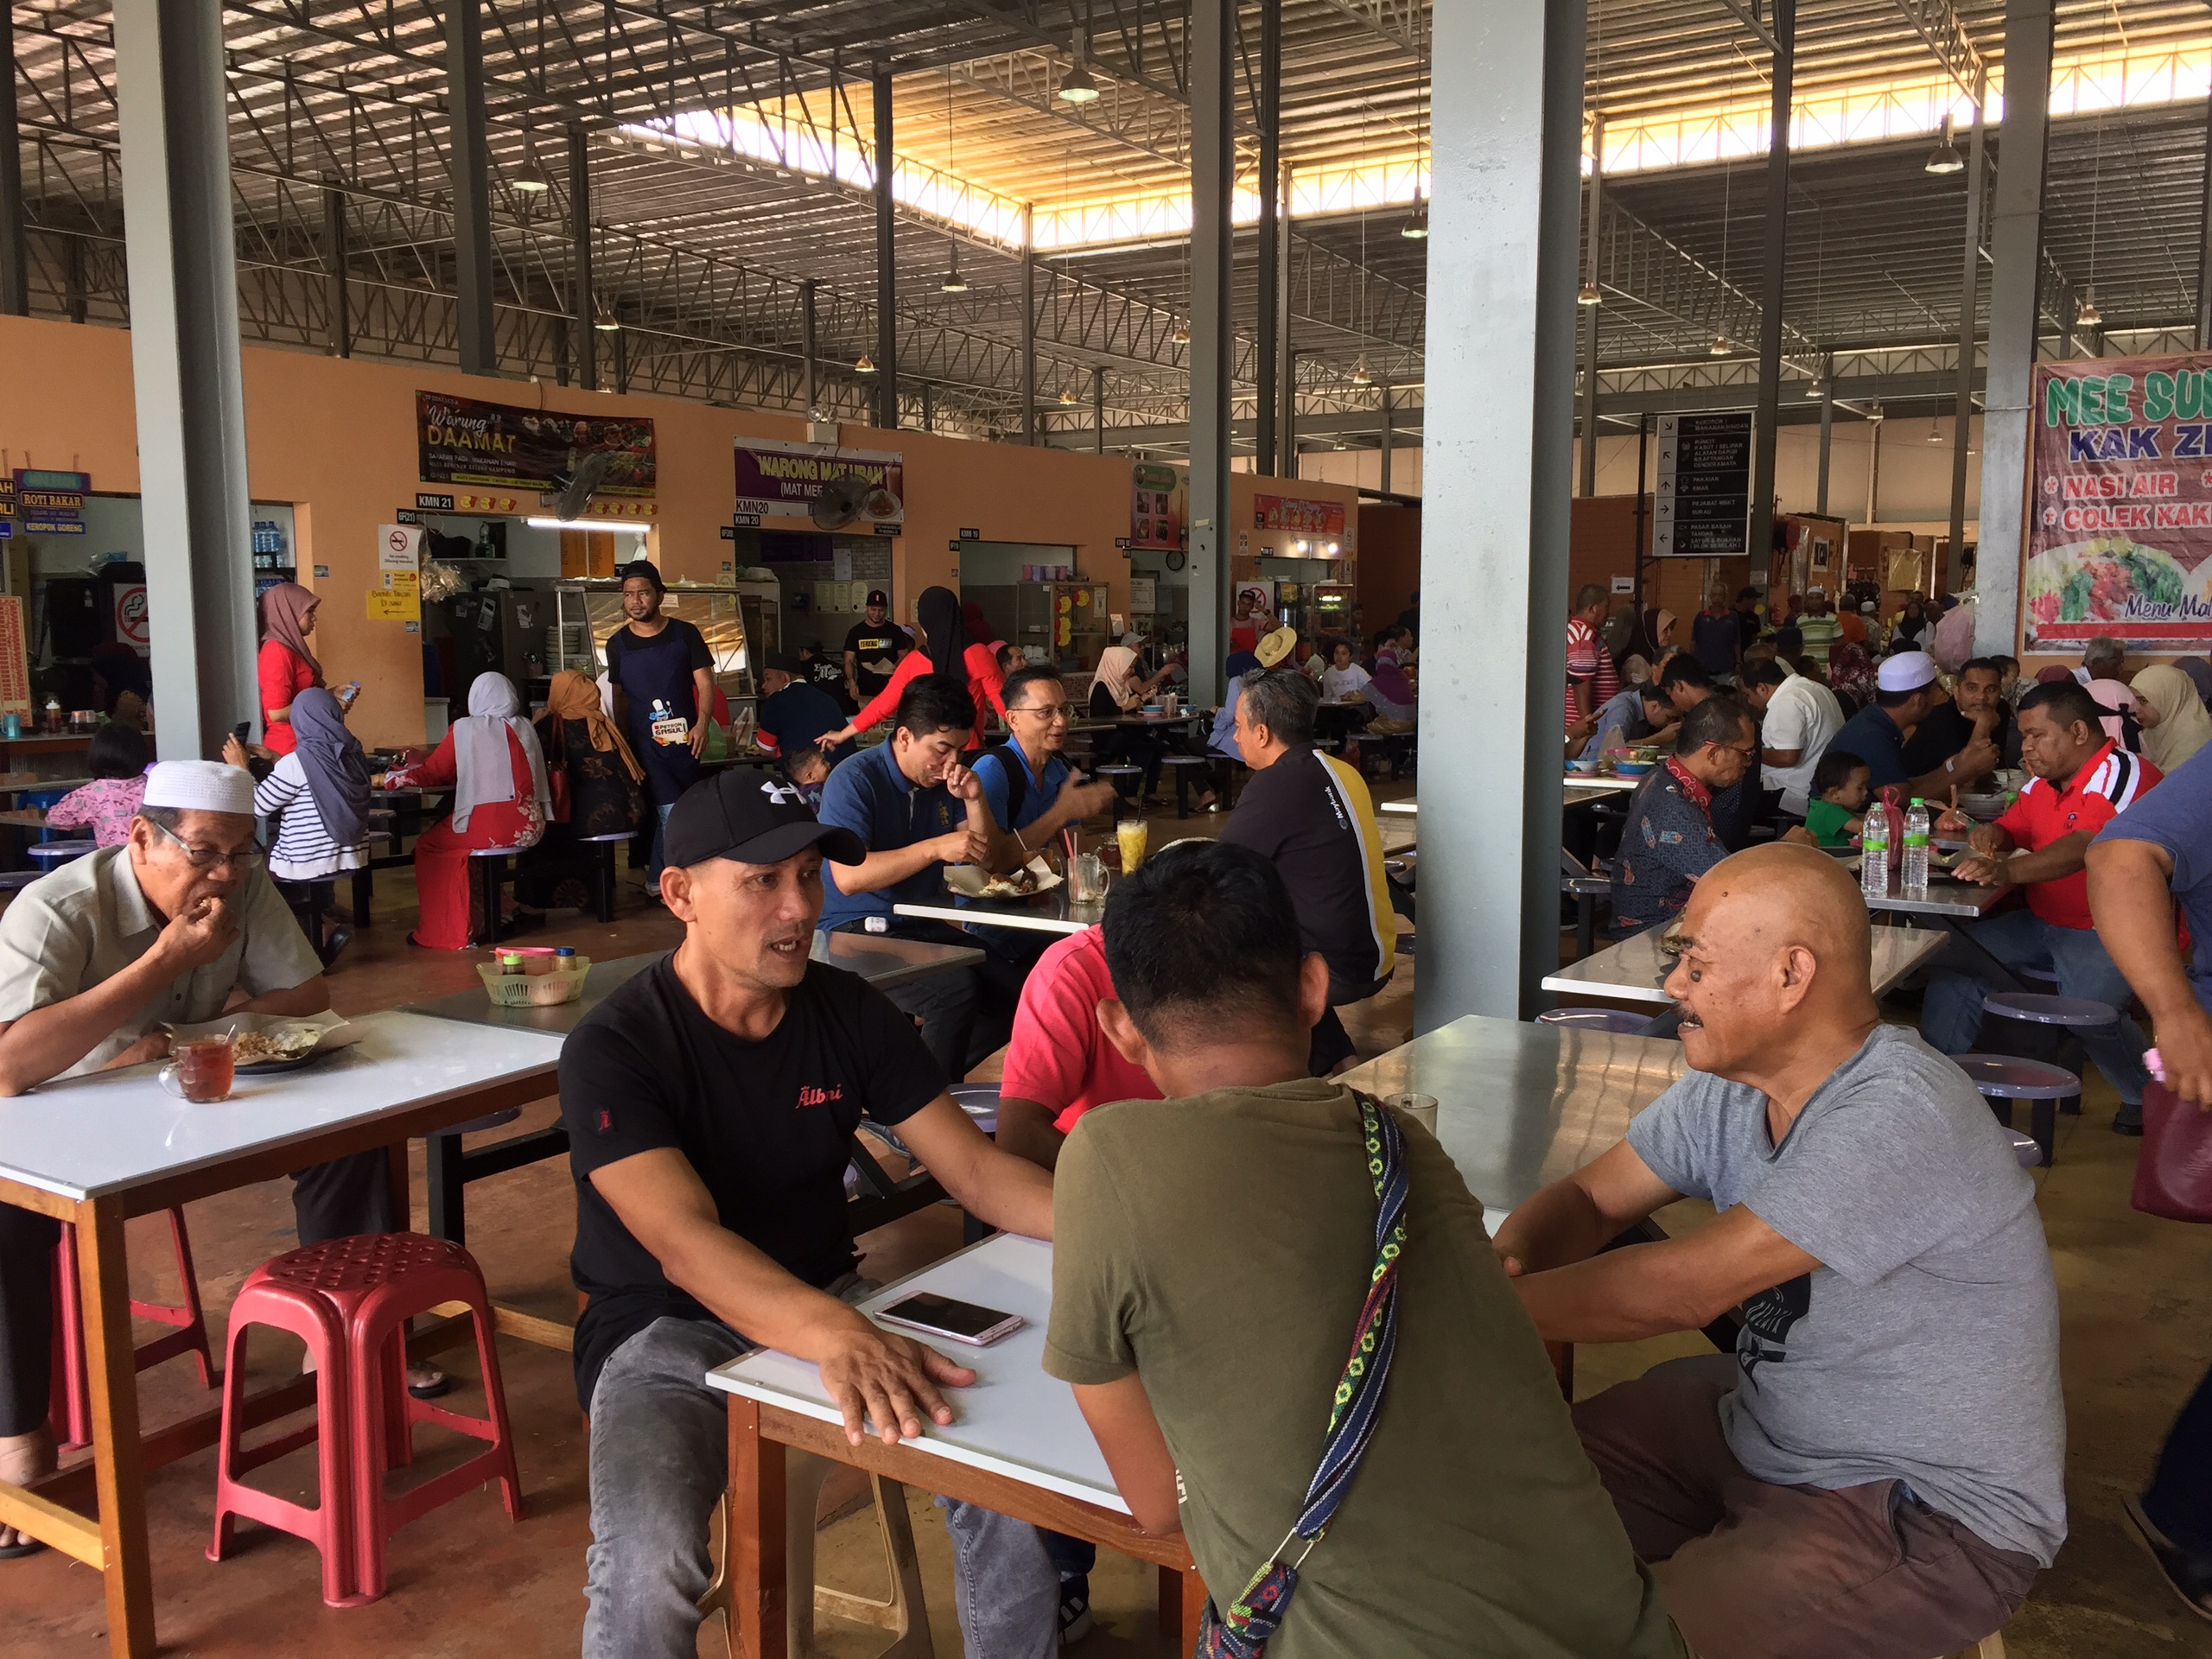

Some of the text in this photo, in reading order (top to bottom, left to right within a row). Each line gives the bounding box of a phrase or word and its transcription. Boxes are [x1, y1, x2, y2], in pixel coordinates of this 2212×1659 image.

[2046, 373, 2134, 427] MEE
[428, 424, 517, 454] DAAMAT
[2069, 427, 2162, 462] KAK
[758, 455, 818, 480] WARONG
[780, 481, 802, 496] (MAT
[2065, 474, 2176, 499] NASI AIR
[23, 494, 81, 506] ROTI BAKAR
[419, 495, 452, 508] KMN 21
[736, 499, 769, 514] KMN20
[735, 515, 759, 525] KMN 20
[2063, 508, 2151, 529] COLEK
[2125, 594, 2172, 619] Menu
[1325, 785, 1344, 819] Maybank
